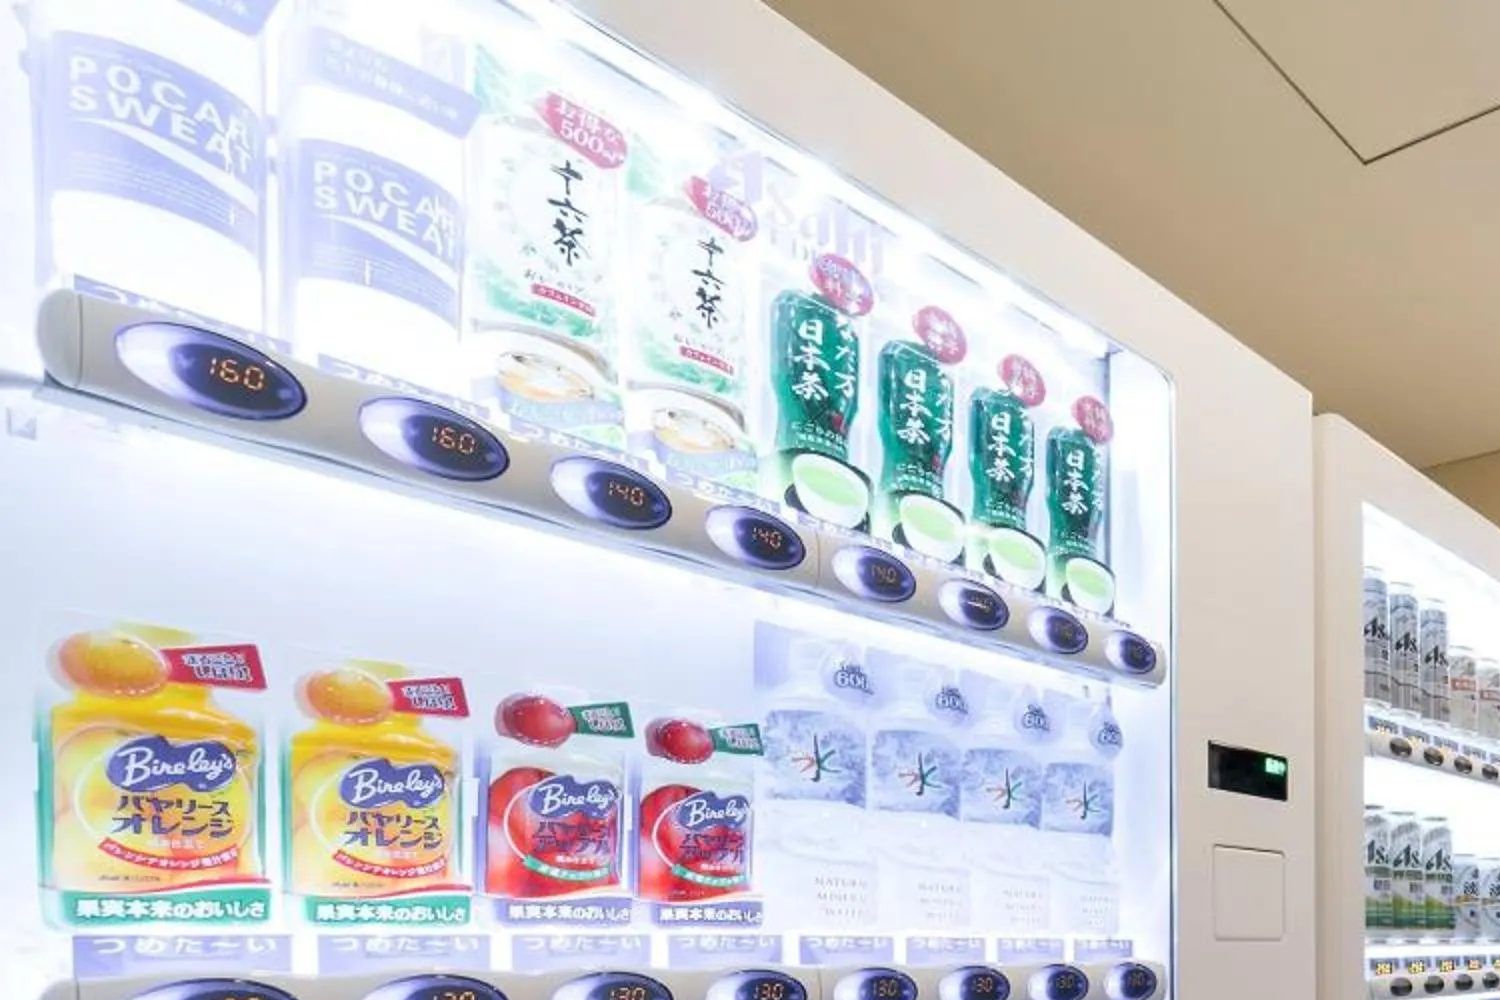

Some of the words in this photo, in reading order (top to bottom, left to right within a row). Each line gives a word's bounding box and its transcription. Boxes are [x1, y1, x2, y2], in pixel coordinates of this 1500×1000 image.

[70, 55, 250, 150] POCAR
[315, 160, 455, 230] POCAR
[546, 159, 592, 268] 十六茶
[690, 236, 728, 329] 十六茶
[209, 356, 266, 392] 160
[792, 319, 831, 400] 日本茶
[897, 369, 934, 448] 日本茶
[431, 425, 476, 456] 160
[986, 412, 1017, 482] 日本茶
[608, 479, 645, 508] 140
[1062, 450, 1089, 514] 日本茶
[752, 526, 782, 551] 140
[117, 795, 231, 817] バヤリース
[345, 811, 440, 831] バヤリース
[110, 813, 234, 838] オレンジ
[342, 829, 443, 850] オレンジ
[75, 898, 267, 921] 果実本来のおいしさ
[316, 903, 467, 923] 果実本来のおいしさ
[873, 979, 898, 998] 130
